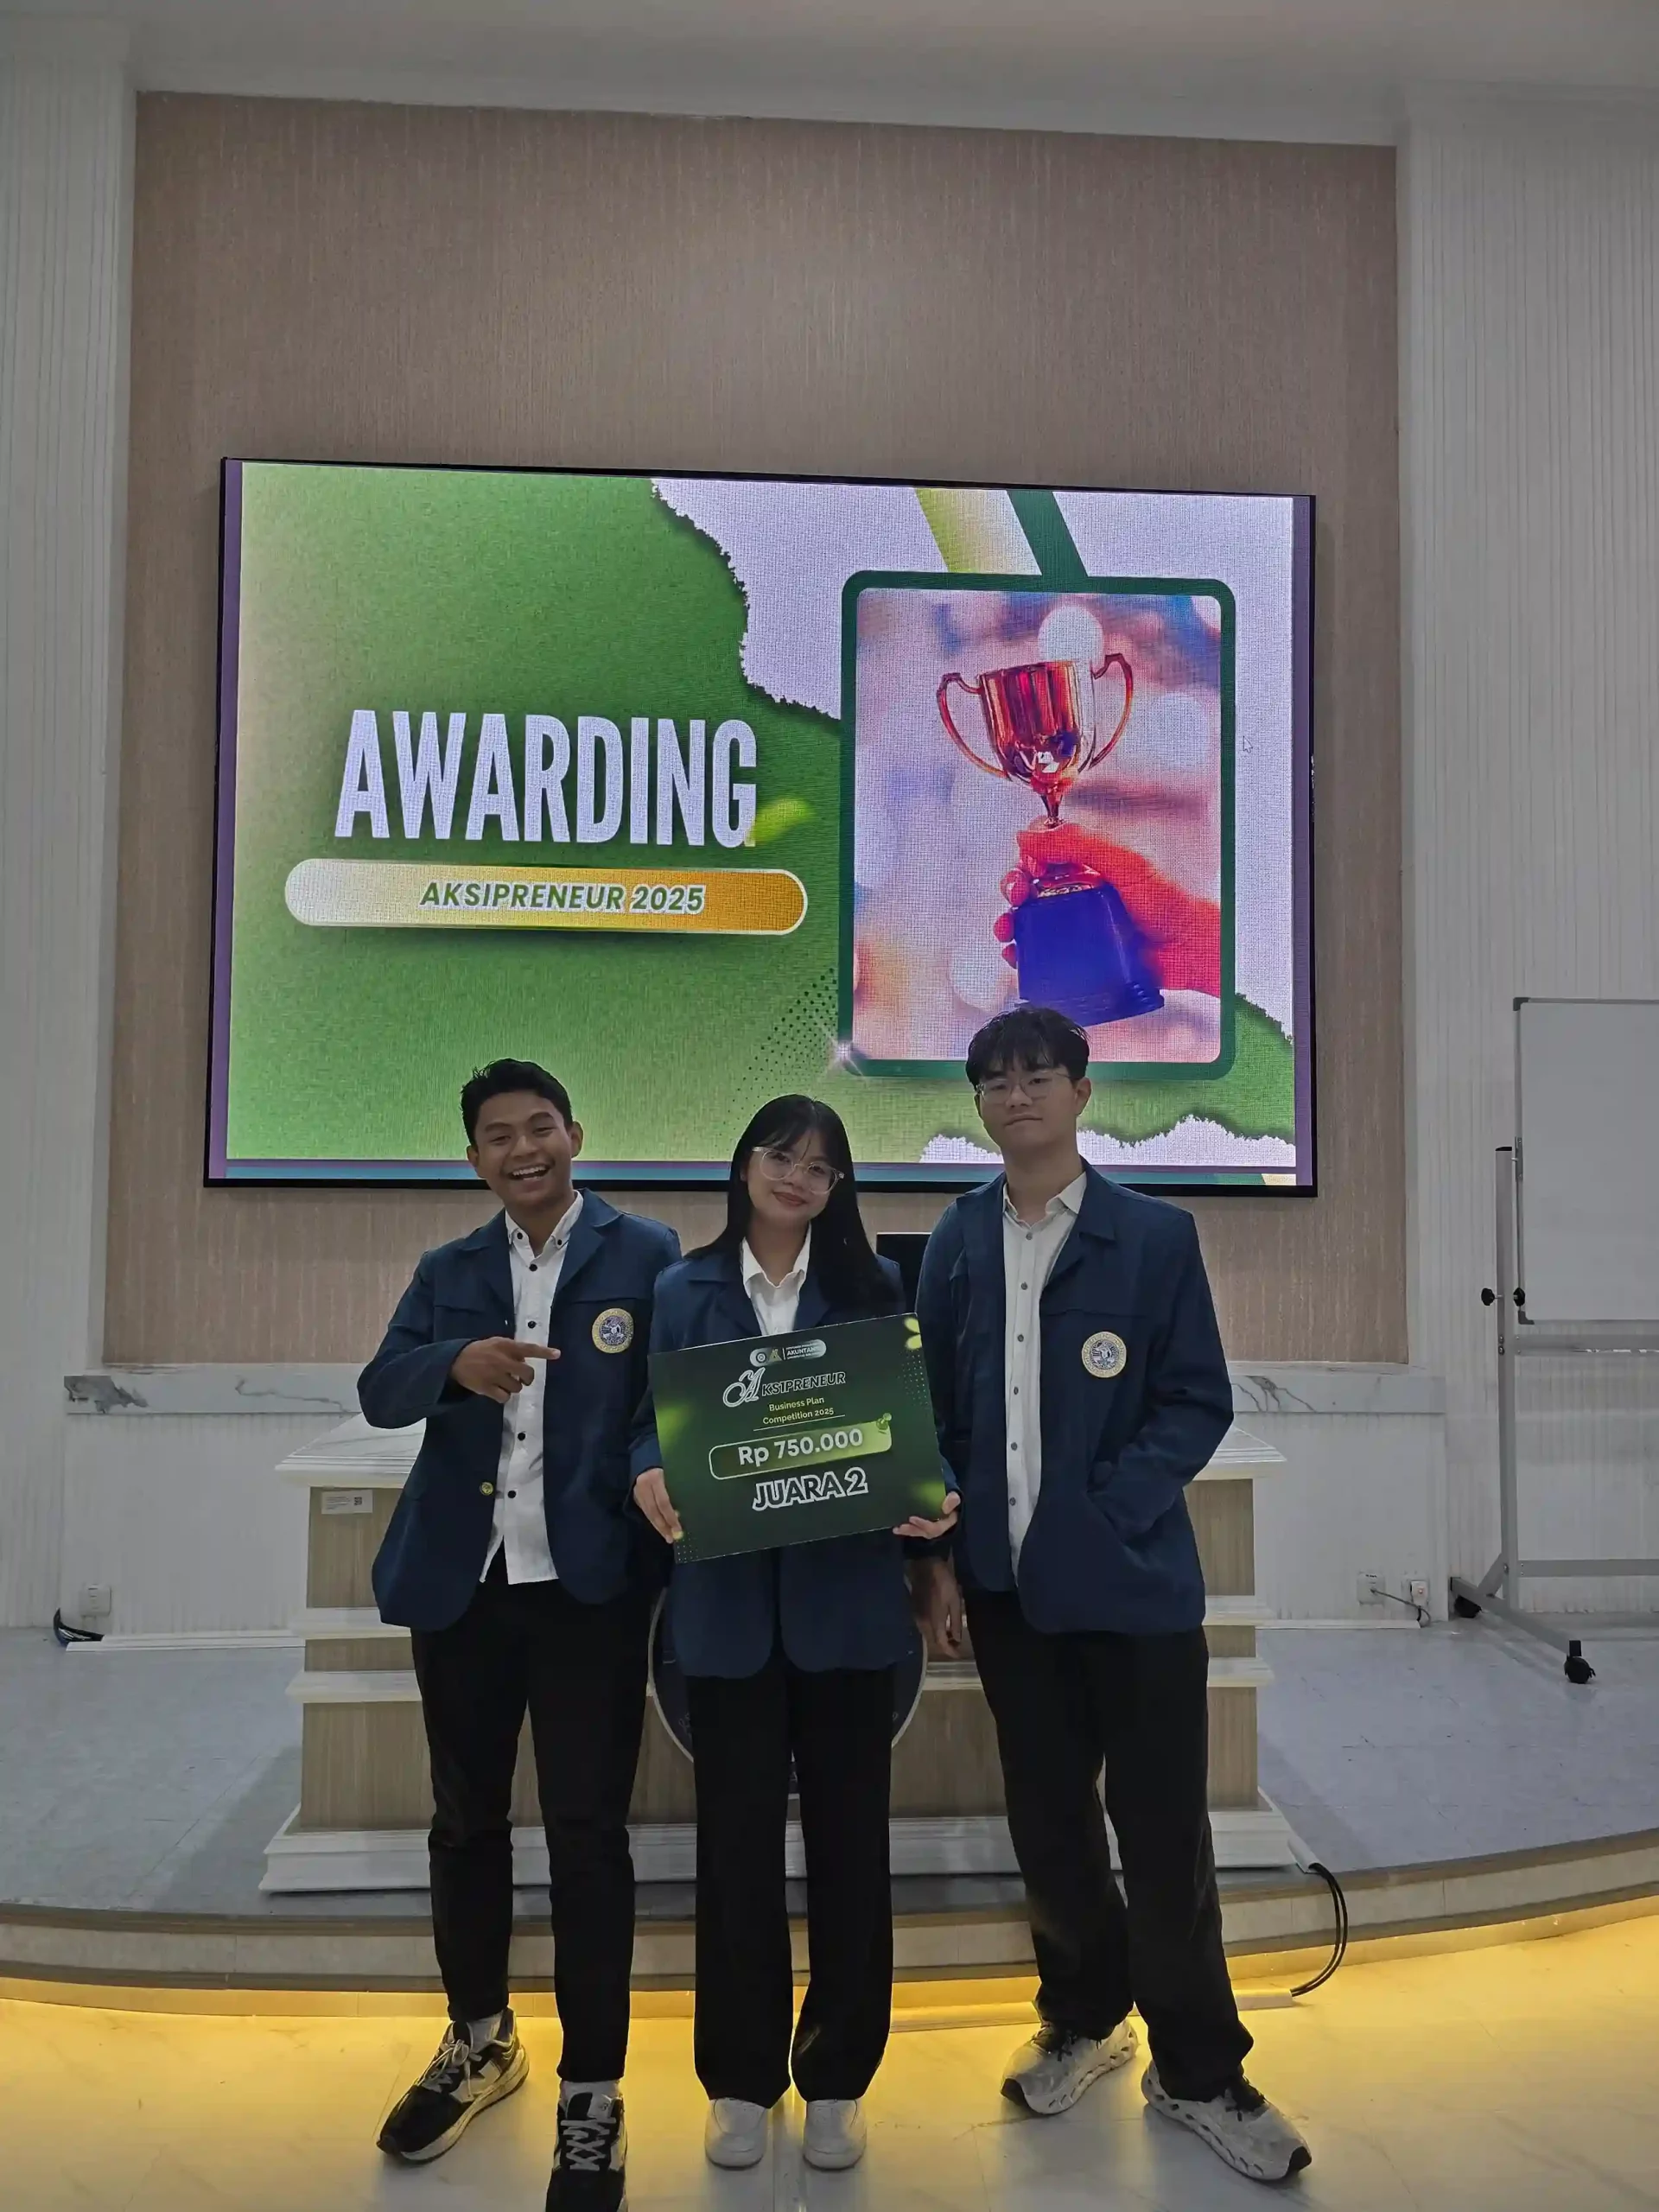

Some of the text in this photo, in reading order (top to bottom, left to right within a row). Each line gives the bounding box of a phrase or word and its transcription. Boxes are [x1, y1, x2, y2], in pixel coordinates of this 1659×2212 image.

[334, 709, 757, 848] AWARDING
[419, 881, 706, 913] AKSIPRENEUR 2025
[762, 1408, 835, 1425] Competition 2025
[769, 1397, 824, 1412] Business Plan
[738, 1428, 863, 1467] Rp 750.000
[752, 1466, 868, 1511] JUARA 2
